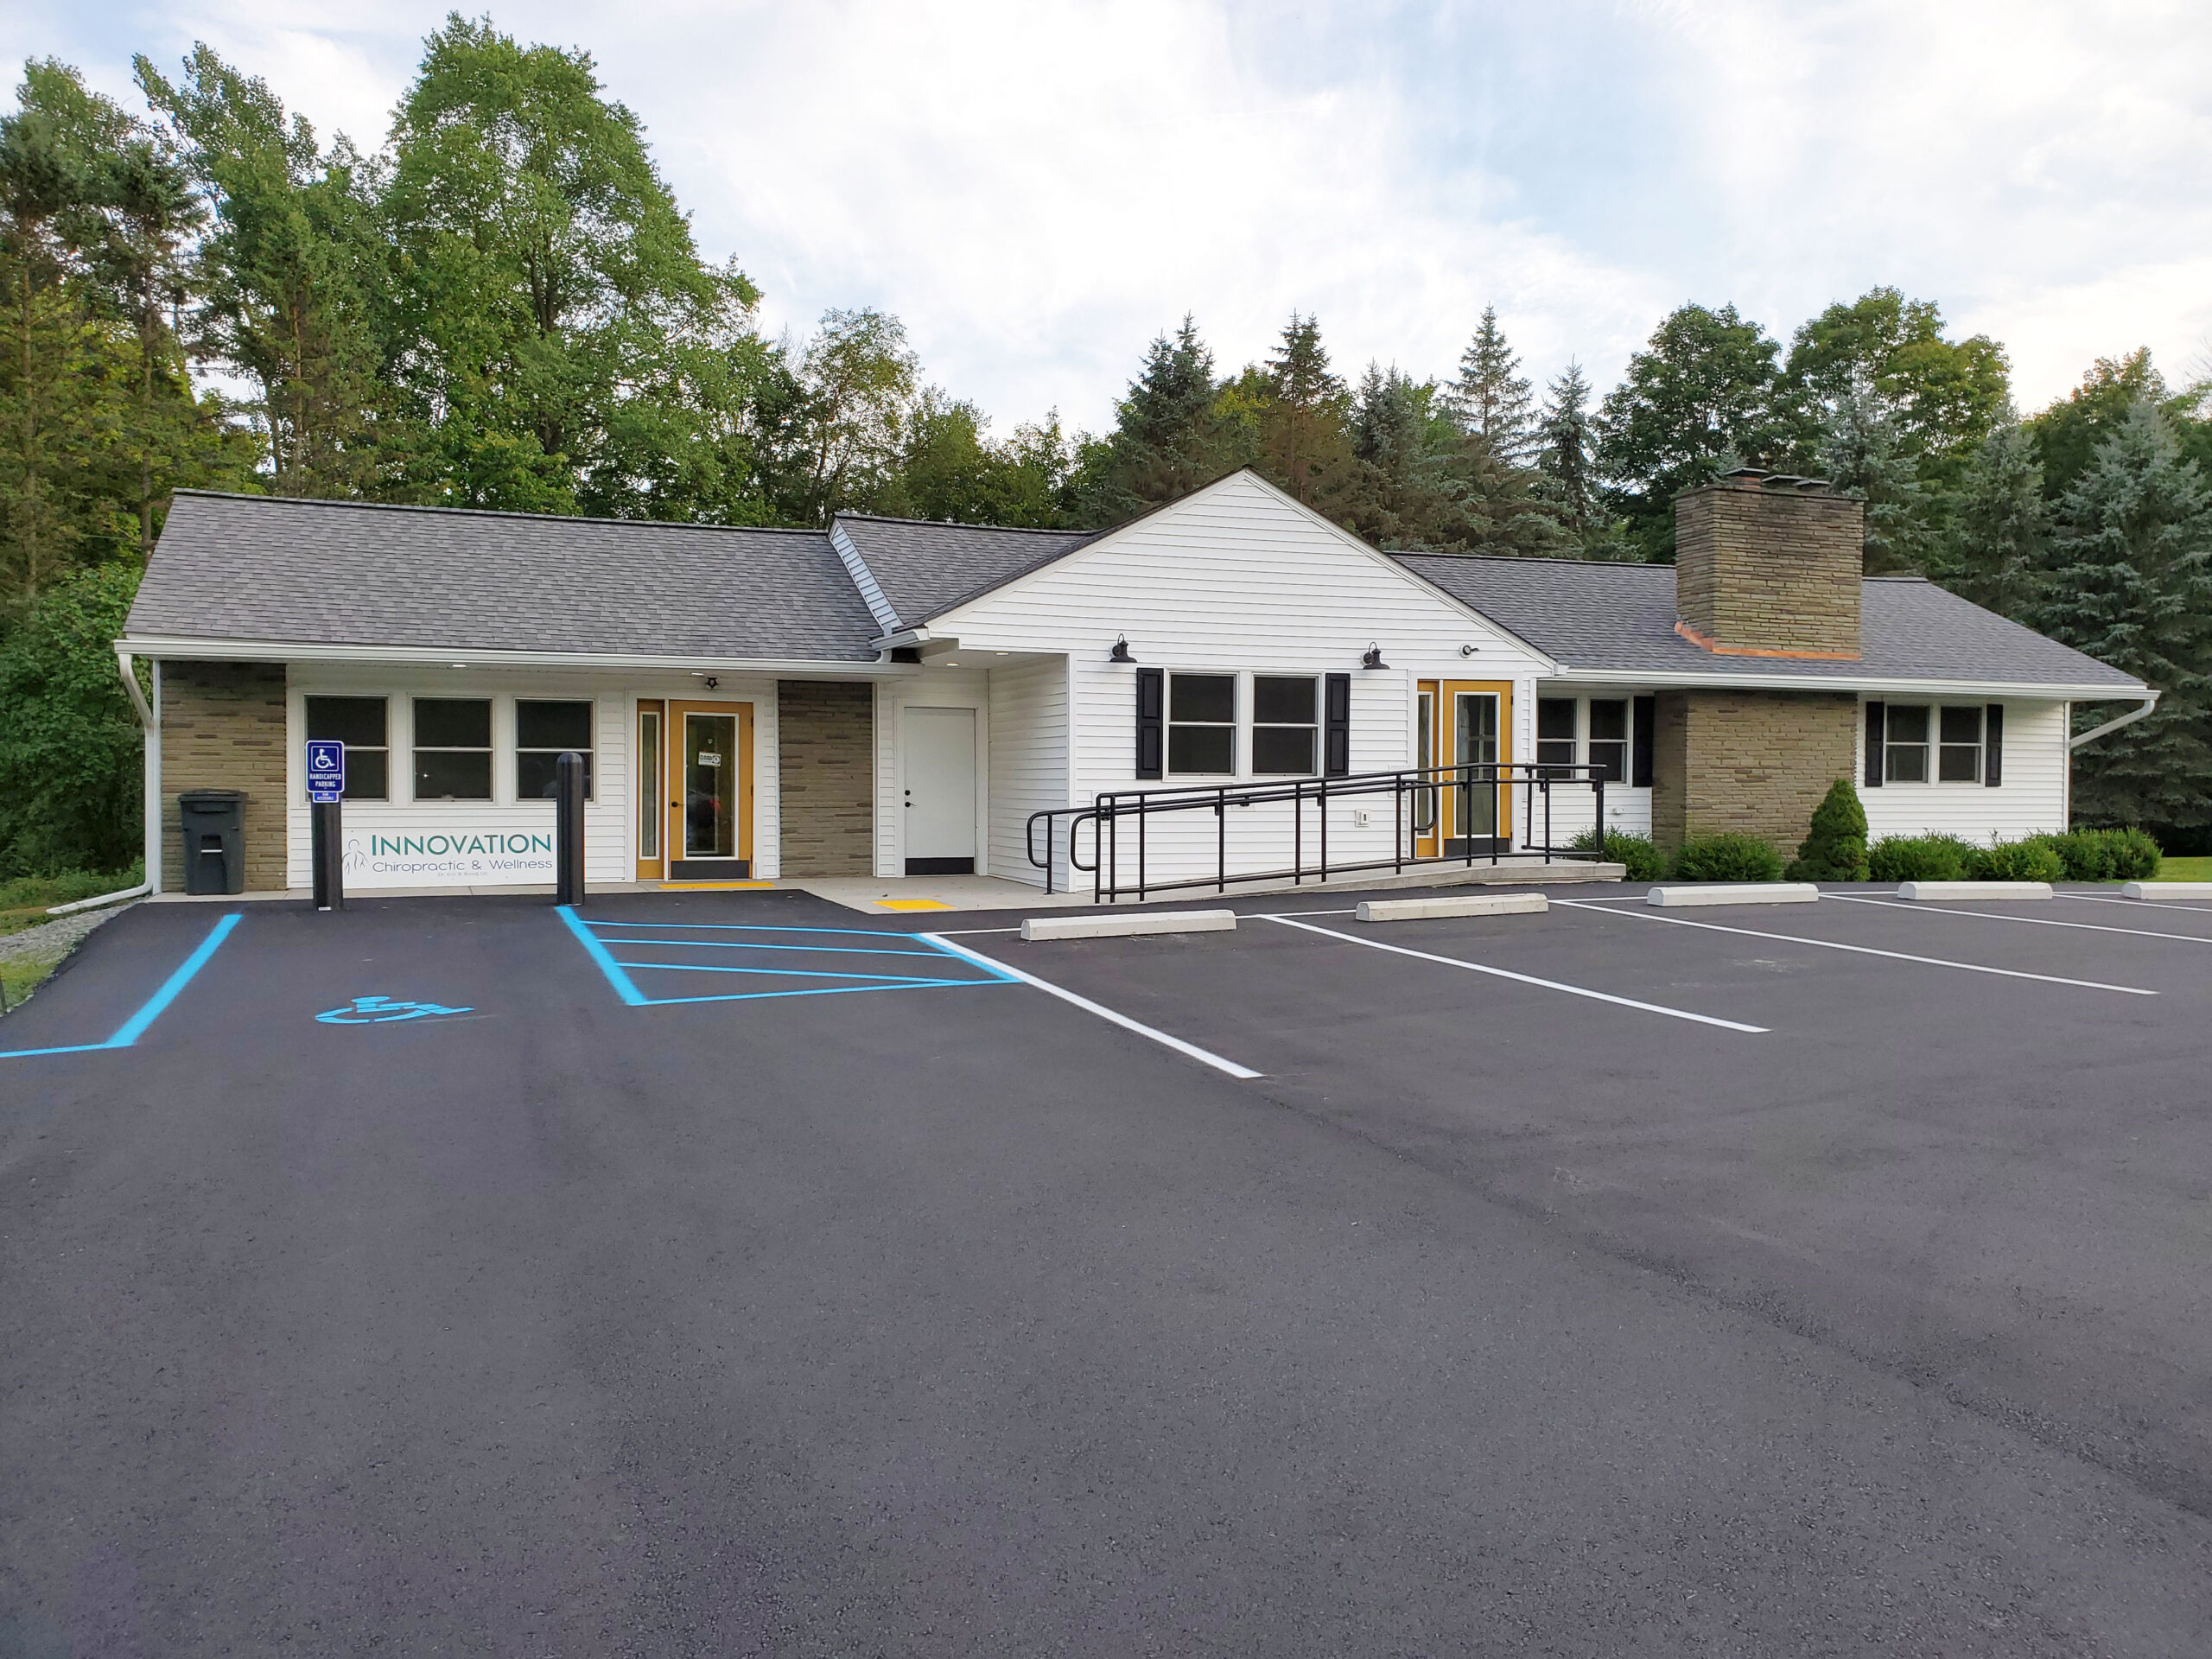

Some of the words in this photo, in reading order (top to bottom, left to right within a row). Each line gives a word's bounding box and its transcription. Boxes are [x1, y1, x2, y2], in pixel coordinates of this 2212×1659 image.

[372, 834, 551, 855] INNOVATION
[372, 860, 465, 874] Chiropractic
[472, 860, 482, 870] &
[488, 859, 553, 870] Wellness
